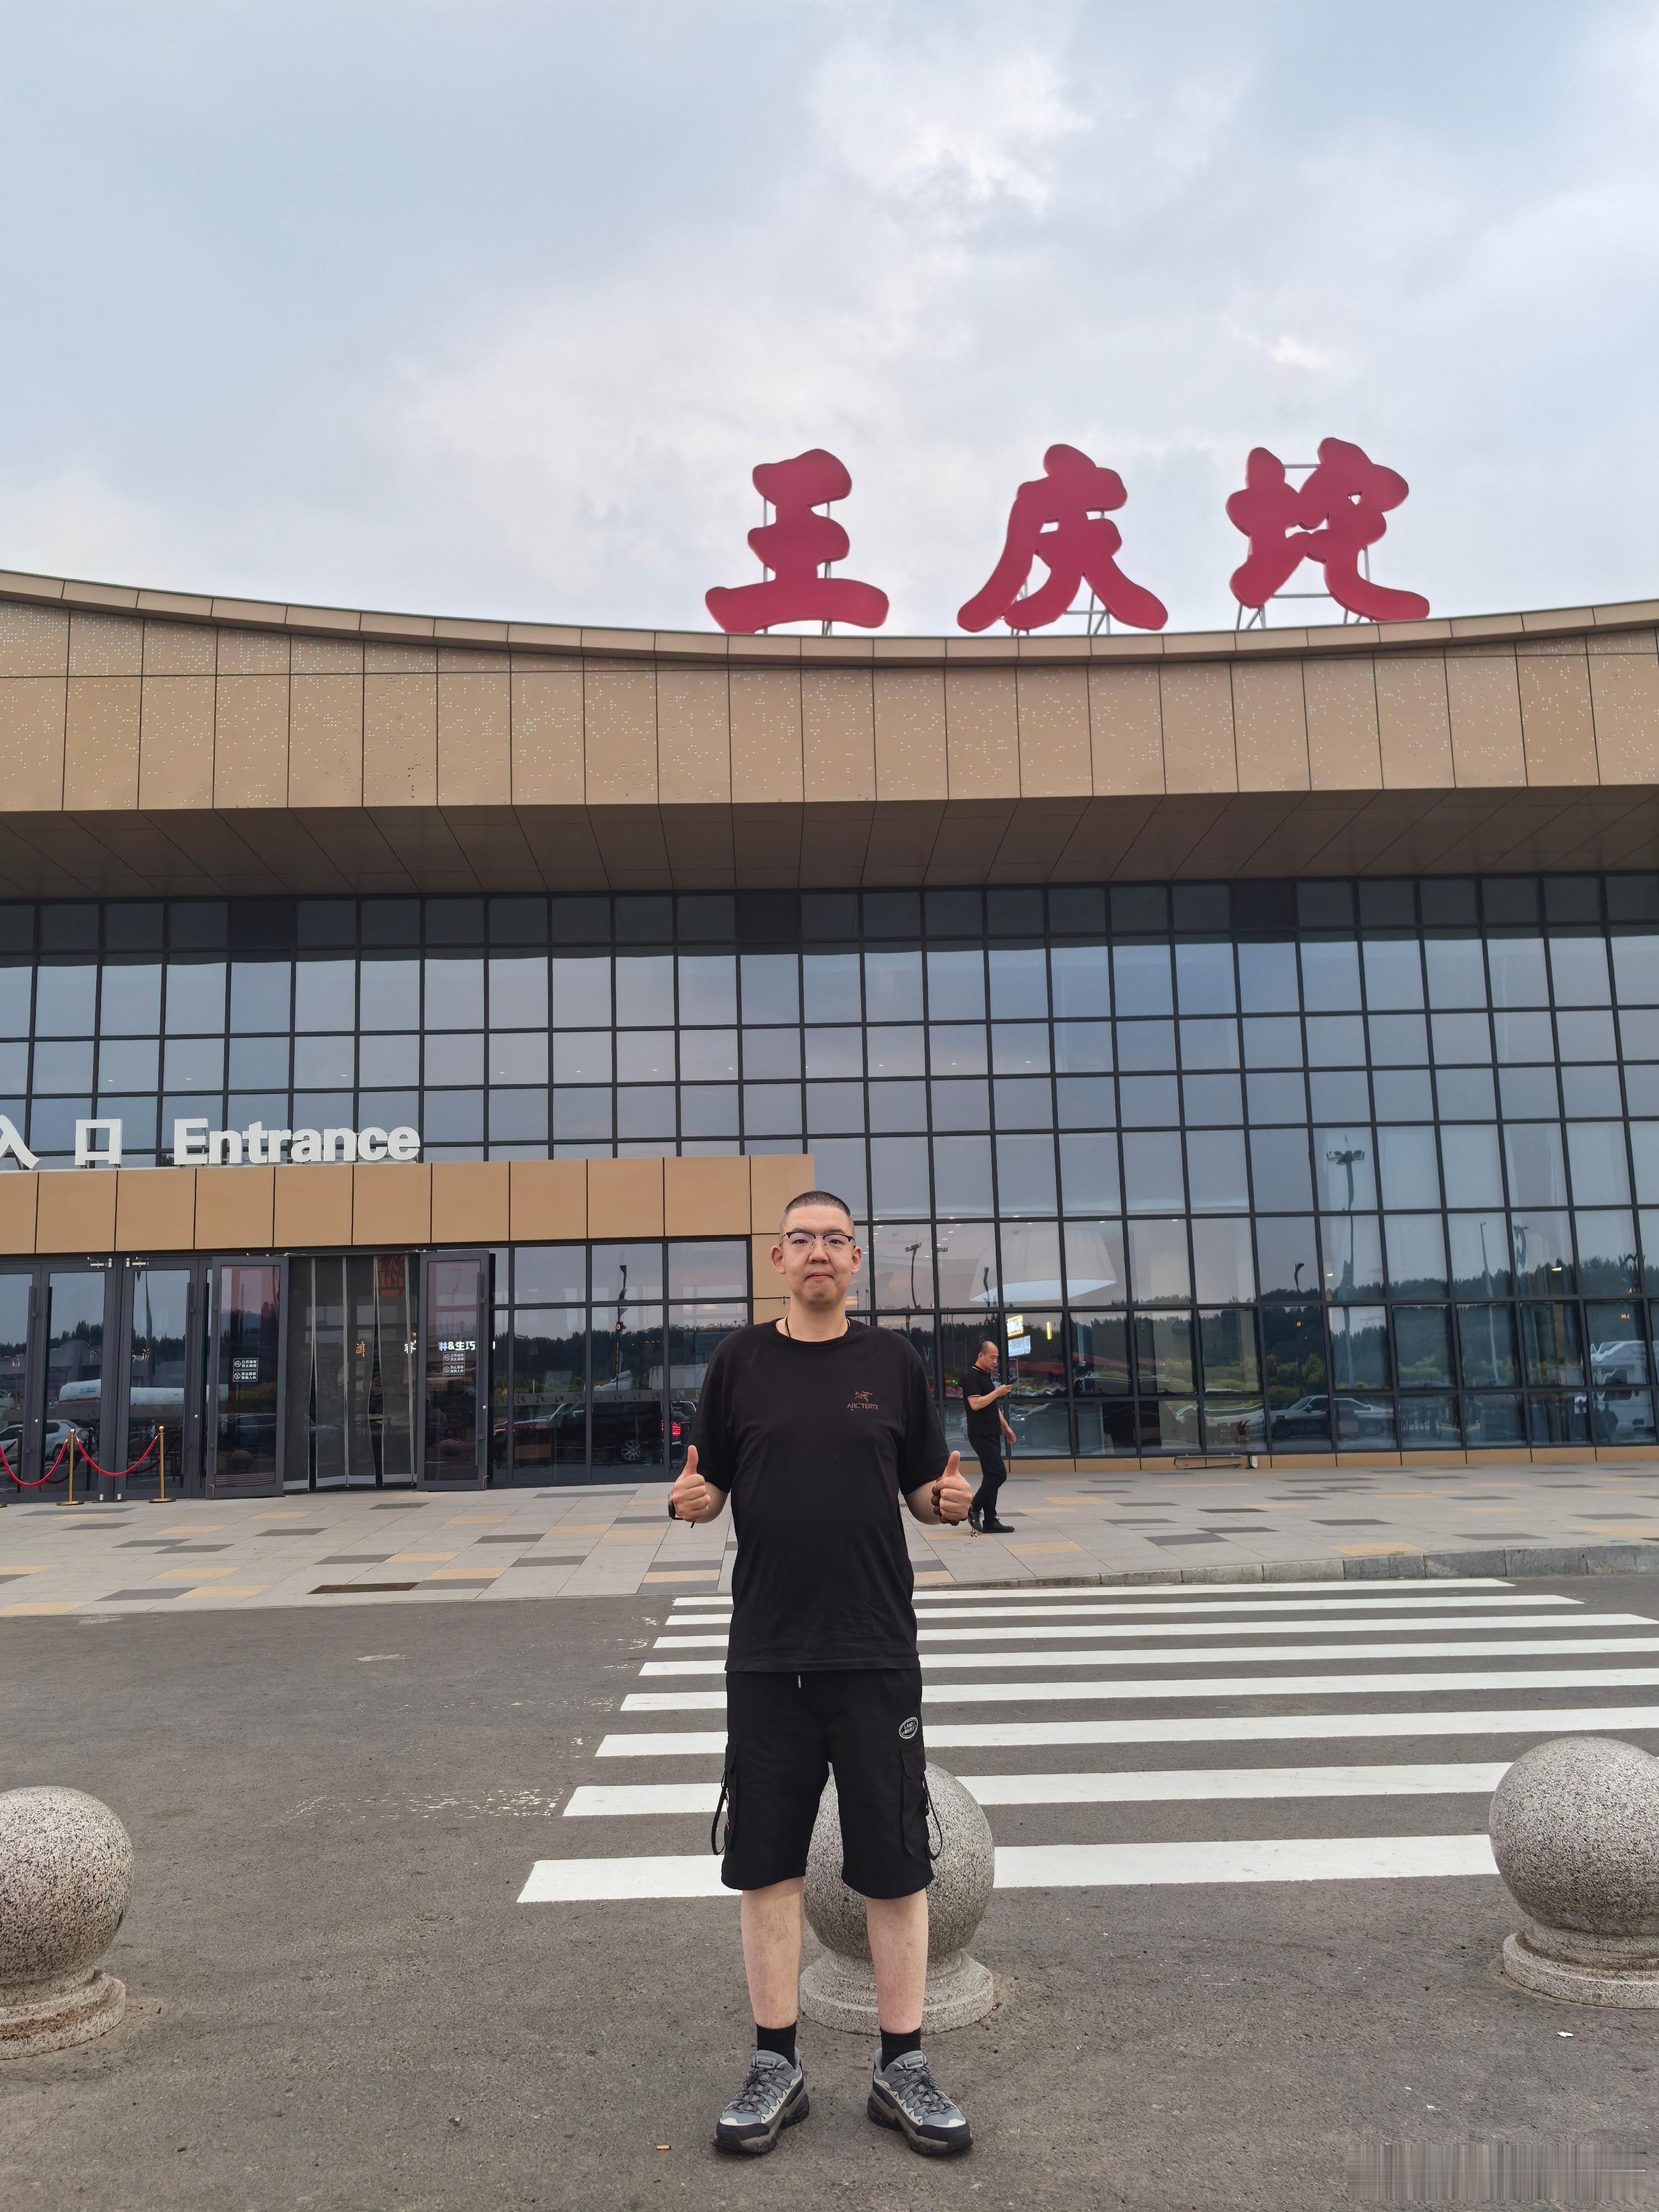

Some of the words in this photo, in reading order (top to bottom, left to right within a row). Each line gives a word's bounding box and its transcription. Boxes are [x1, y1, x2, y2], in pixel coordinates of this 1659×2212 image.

[705, 437, 1430, 633] 王庆坨
[0, 1114, 123, 1170] 入口
[173, 1118, 421, 1165] Entrance
